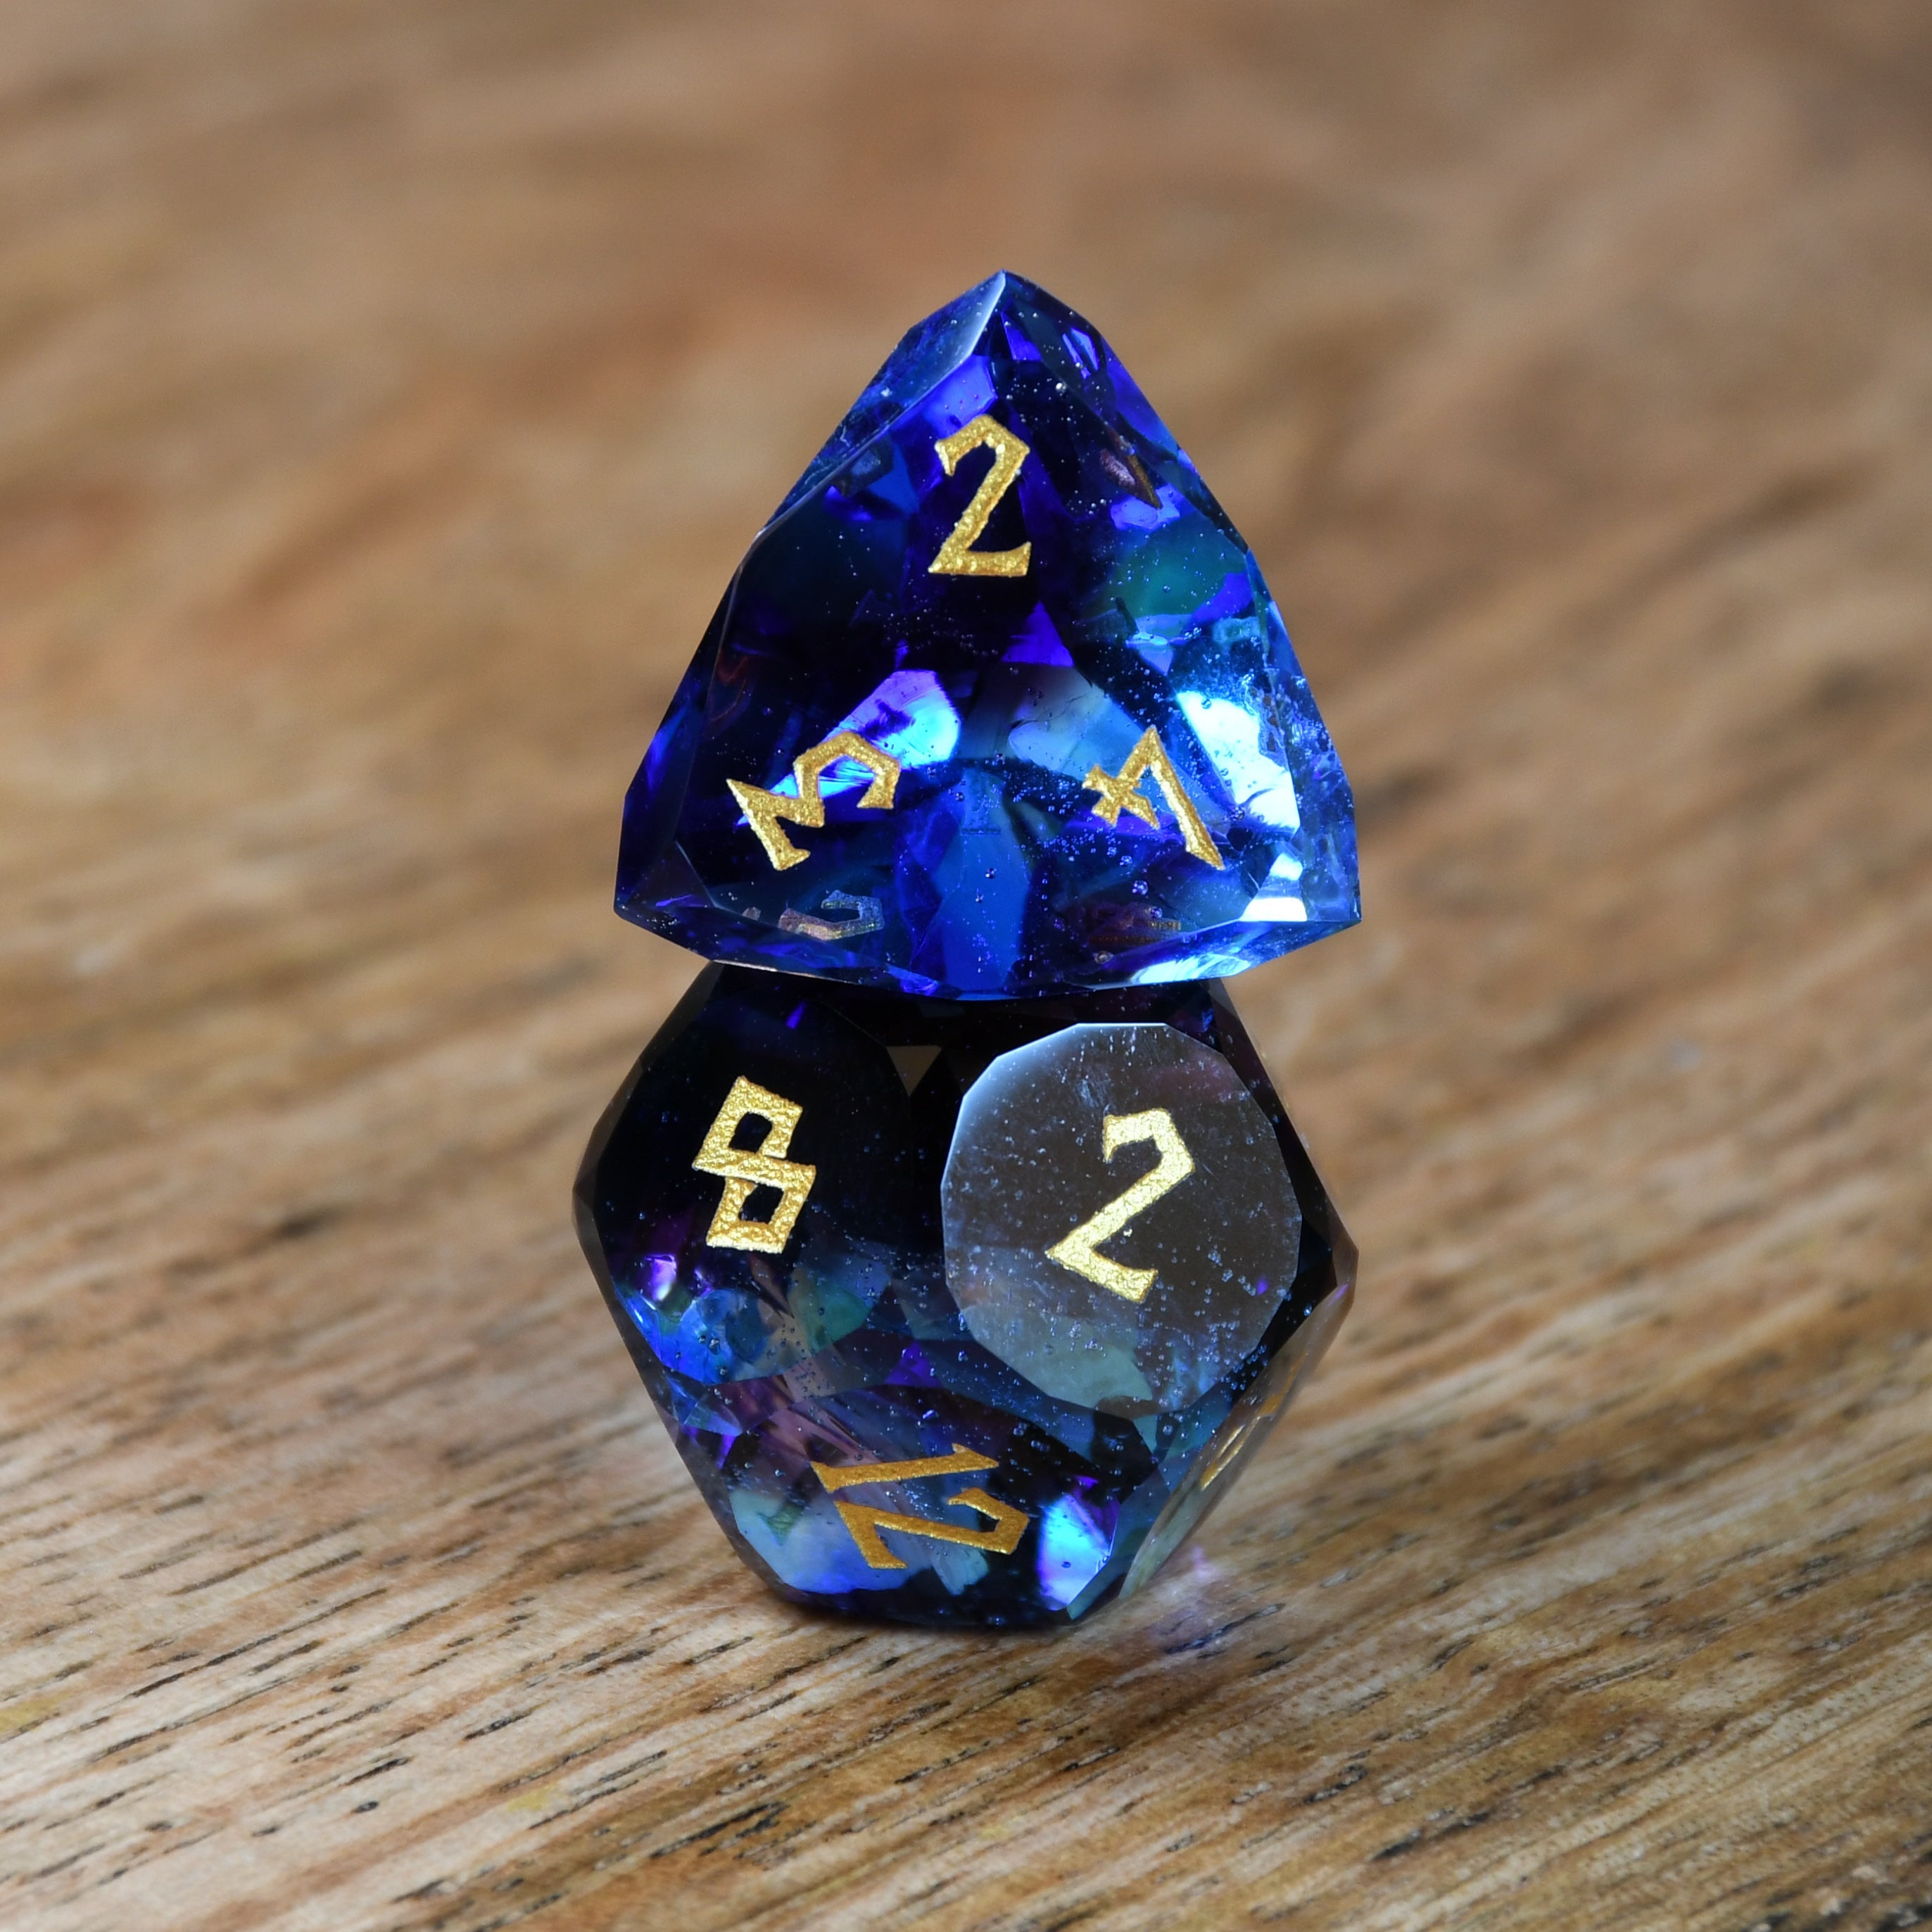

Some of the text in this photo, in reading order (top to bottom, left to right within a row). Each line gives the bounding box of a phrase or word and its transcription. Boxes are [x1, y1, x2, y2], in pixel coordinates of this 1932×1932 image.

[927, 414, 1031, 576] 2
[726, 730, 899, 871] 3
[1082, 726, 1225, 870] 4
[693, 1075, 816, 1254] 8
[1045, 1107, 1196, 1303] 2
[814, 1443, 1030, 1570] 12
